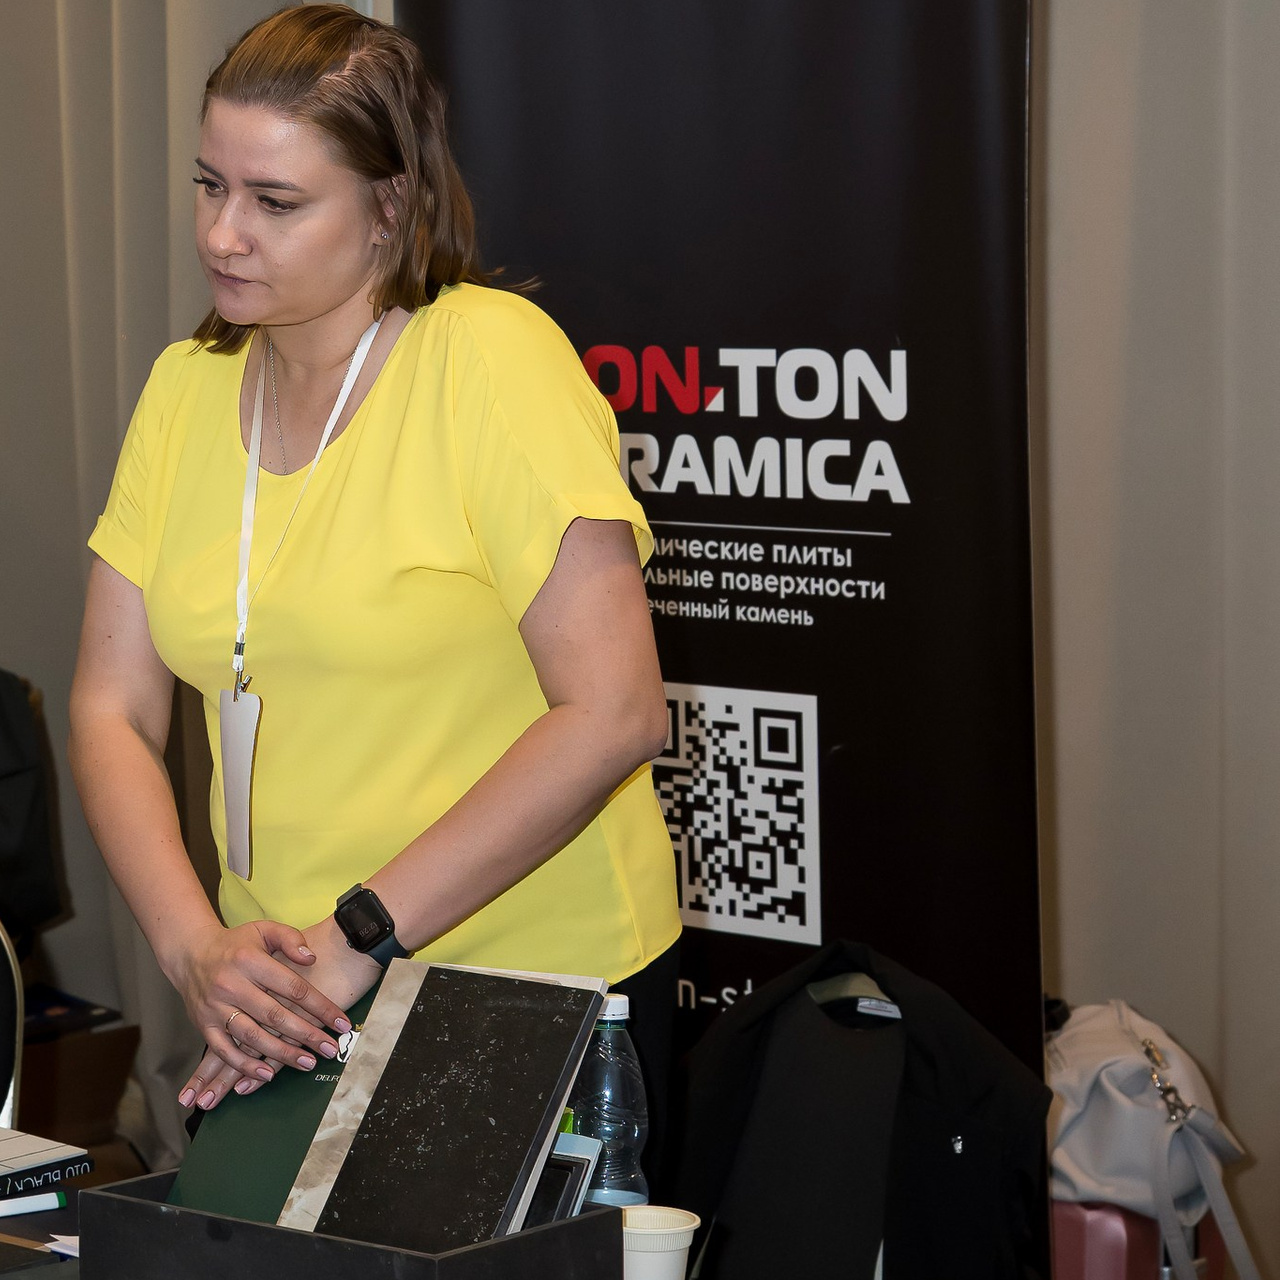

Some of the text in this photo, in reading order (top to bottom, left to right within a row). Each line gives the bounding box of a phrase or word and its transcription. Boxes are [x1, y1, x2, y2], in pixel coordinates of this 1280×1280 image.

[619, 433, 911, 505] RAMICA
[772, 544, 852, 567] плиты
[721, 571, 886, 600] поверхности
[735, 604, 815, 626] камень
